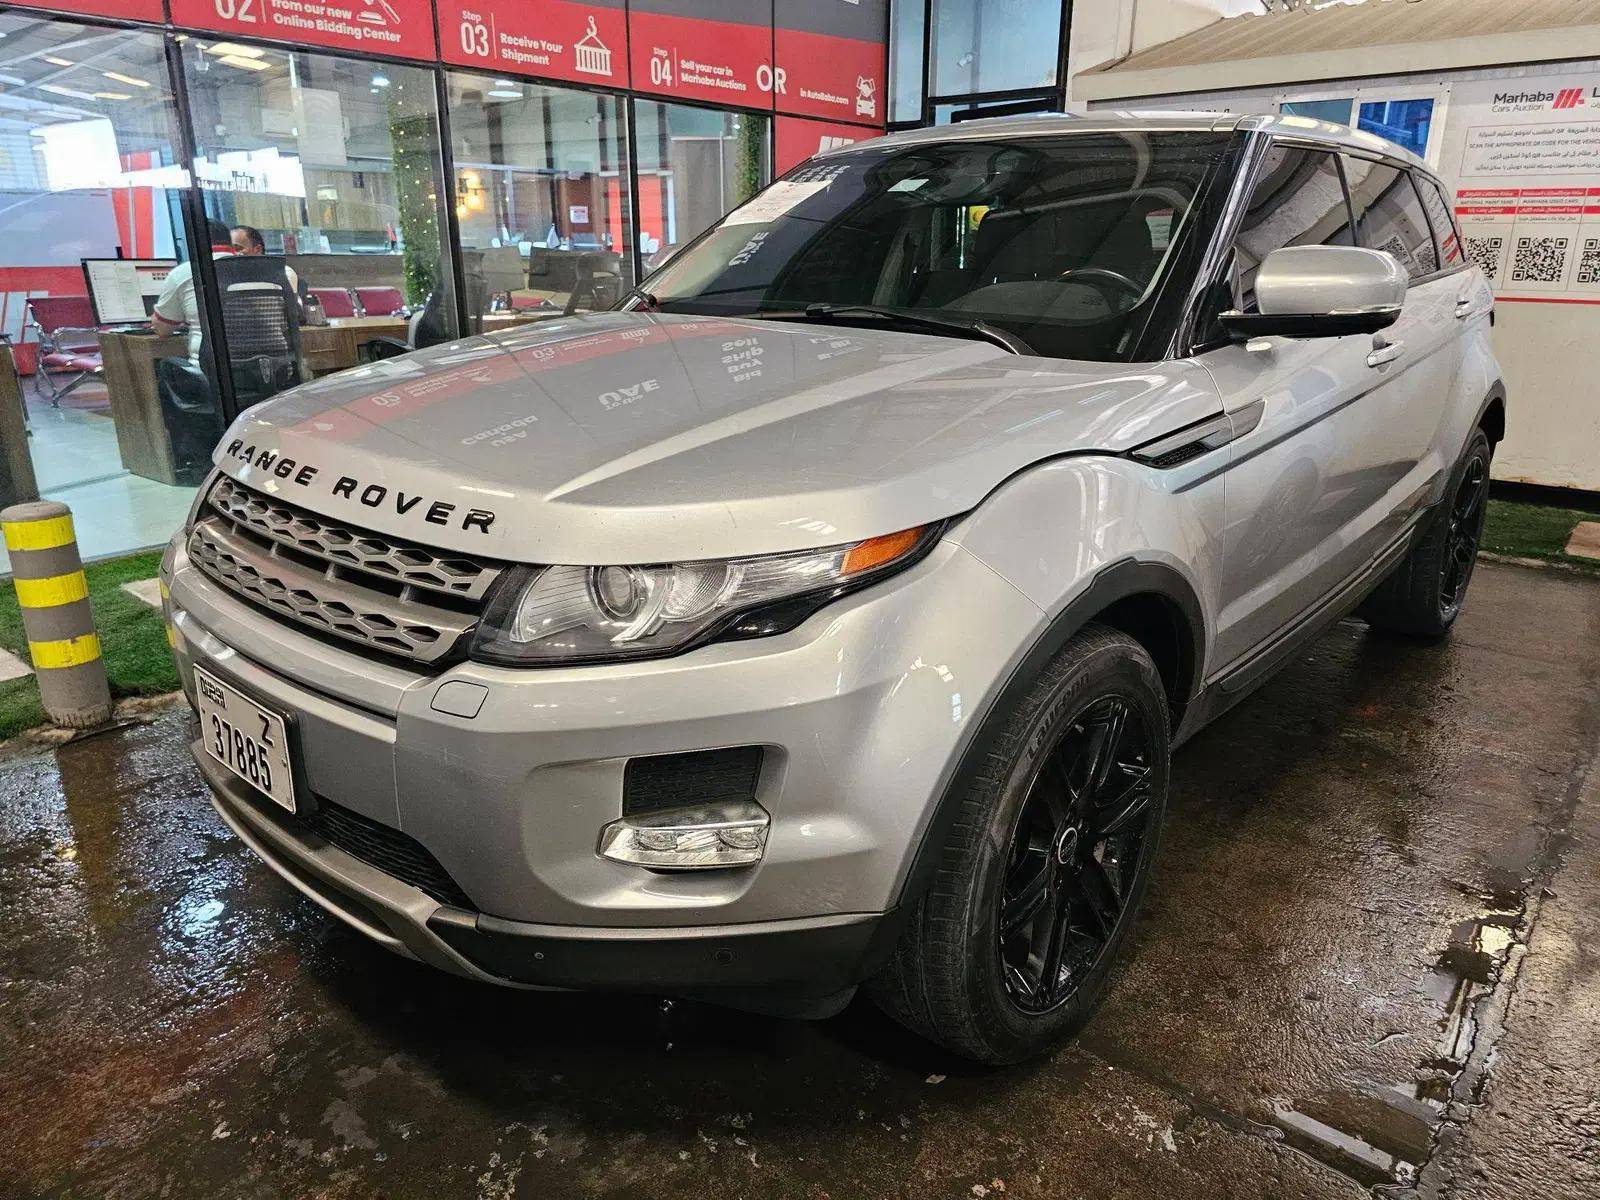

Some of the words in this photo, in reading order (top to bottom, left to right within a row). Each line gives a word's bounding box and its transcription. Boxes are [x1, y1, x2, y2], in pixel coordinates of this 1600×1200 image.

[303, 2, 326, 14] our
[326, 6, 353, 20] new
[462, 10, 482, 23] Step
[273, 12, 315, 29] Online
[316, 20, 363, 40] Bidding
[362, 26, 402, 43] Center
[460, 22, 490, 57] 03
[500, 32, 540, 49] Receive
[540, 39, 564, 53] Your
[501, 48, 550, 65] Shipment
[653, 47, 668, 59] Step
[650, 57, 672, 87] 04
[680, 59, 695, 70] Sell
[694, 62, 713, 74] your
[713, 65, 725, 76] car
[681, 72, 715, 87] Marhaba
[715, 77, 747, 92] Auctions
[756, 64, 787, 95] OR
[1493, 91, 1555, 104] Marhaba
[1491, 104, 1511, 113] Cars
[1512, 103, 1545, 112] Auction
[227, 439, 319, 487] RANGE
[332, 476, 496, 534] ROVER
[258, 711, 275, 747] Z
[212, 712, 273, 792] 37885
